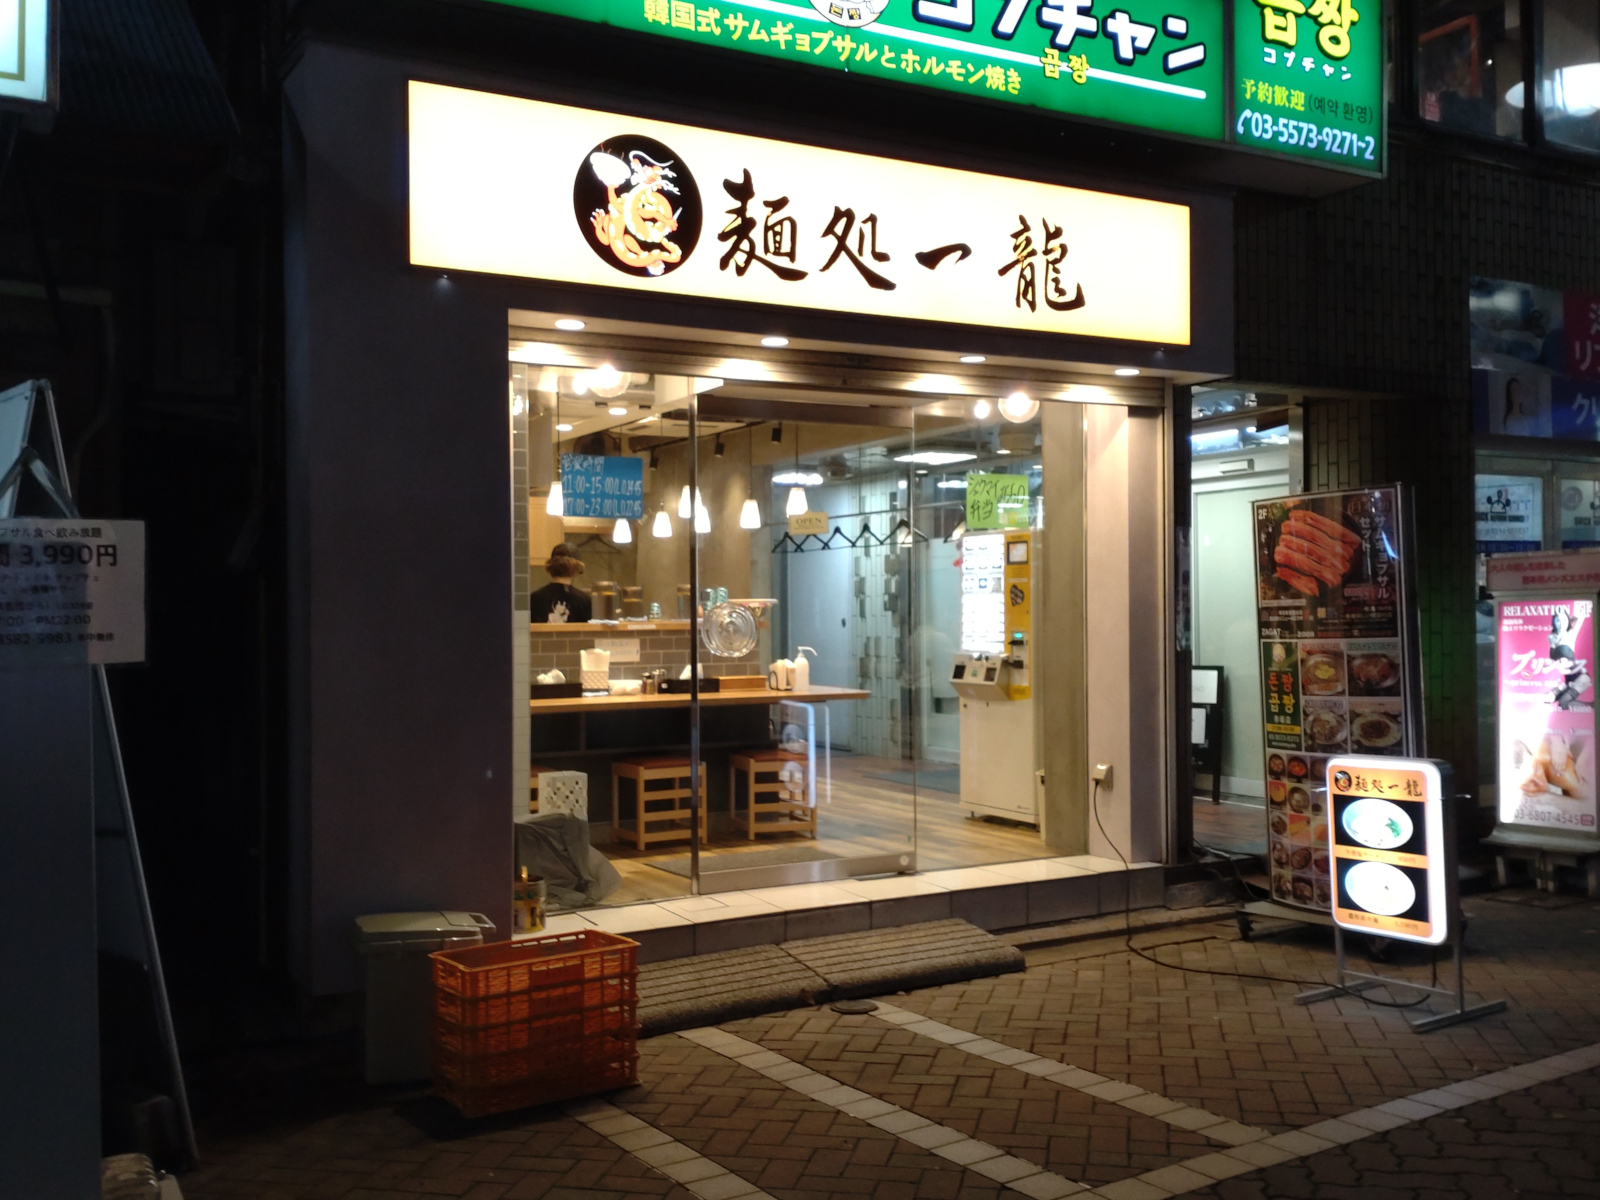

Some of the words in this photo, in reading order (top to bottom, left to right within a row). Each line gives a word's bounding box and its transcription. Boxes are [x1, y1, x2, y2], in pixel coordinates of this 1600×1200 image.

[643, 0, 1022, 95] 韓国式サムギョプサルとホルモン焼き
[717, 167, 1086, 313] 麺処一龍
[795, 517, 822, 525] OPEN
[1503, 604, 1571, 616] RELAXATION
[1353, 774, 1423, 797] 麺処一龍
